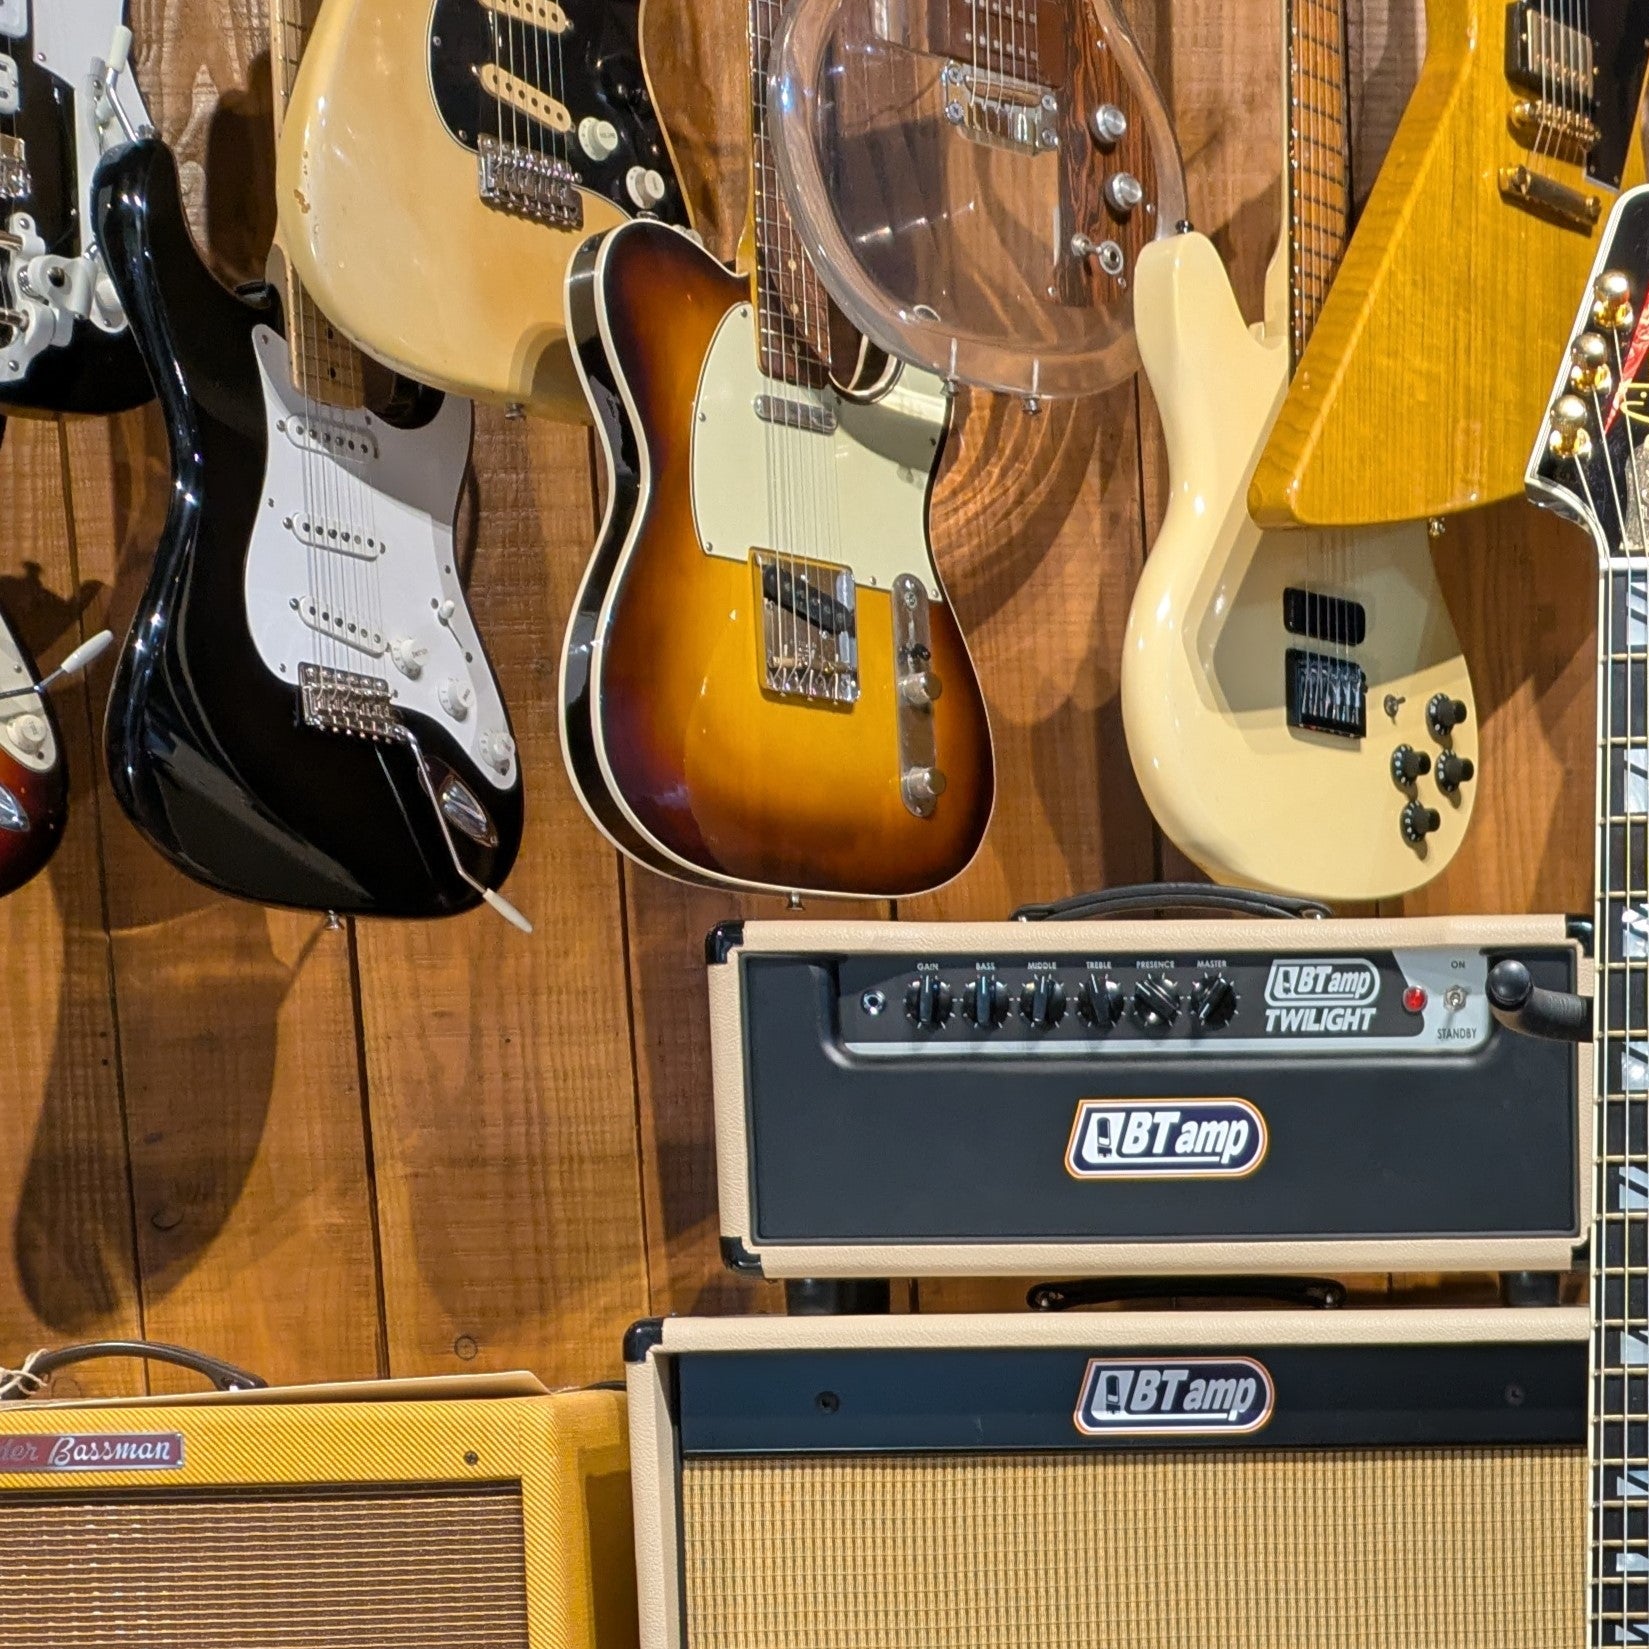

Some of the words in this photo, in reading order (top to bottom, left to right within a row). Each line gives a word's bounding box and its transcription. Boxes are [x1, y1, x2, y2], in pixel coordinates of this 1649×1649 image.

[917, 962, 939, 971] GAIN
[975, 962, 995, 971] BASS
[1027, 961, 1057, 970] MIDDLE
[1086, 961, 1112, 970] TREBLE
[1136, 960, 1175, 969] PRESENCE
[1197, 959, 1227, 968] MASTER
[1451, 960, 1466, 969] ON
[1328, 969, 1371, 999] amp
[1265, 1007, 1376, 1032] TWILIGHT
[1437, 1028, 1477, 1039] STANDBY
[1175, 1119, 1249, 1164] amp
[1183, 1377, 1257, 1421] amp
[47, 1436, 170, 1466] Bassman
